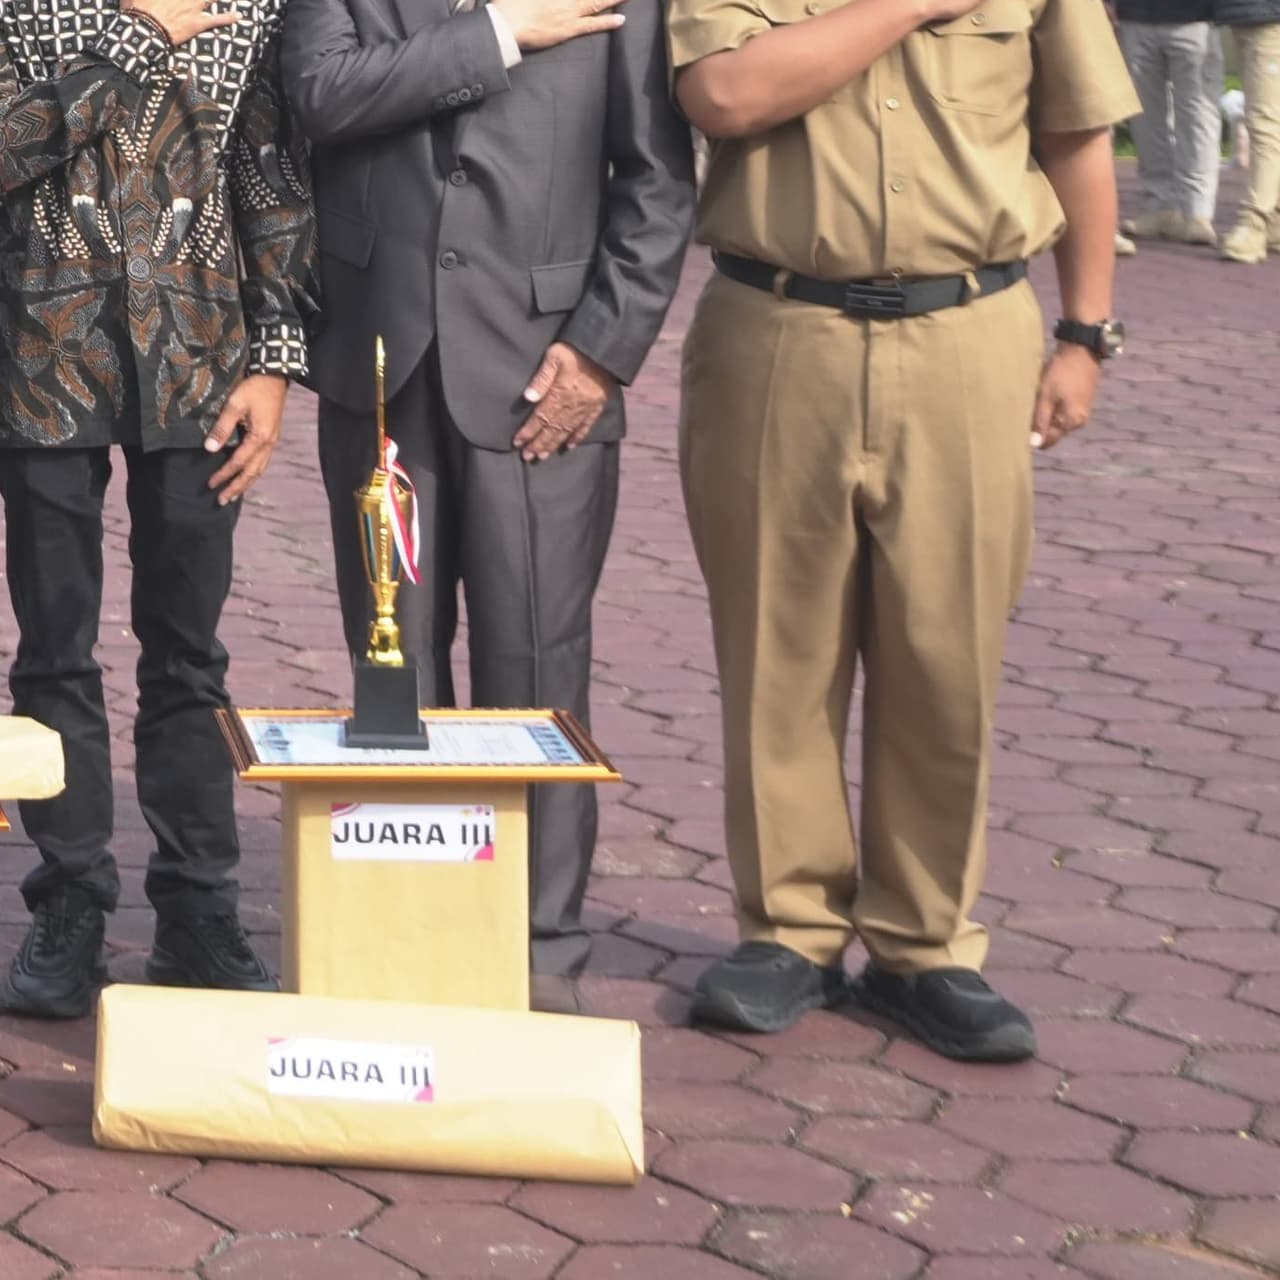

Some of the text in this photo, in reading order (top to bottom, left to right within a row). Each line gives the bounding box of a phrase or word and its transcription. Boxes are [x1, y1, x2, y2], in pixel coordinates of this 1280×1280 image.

[333, 822, 491, 847] JUARA III
[270, 1056, 431, 1089] JUARA III
